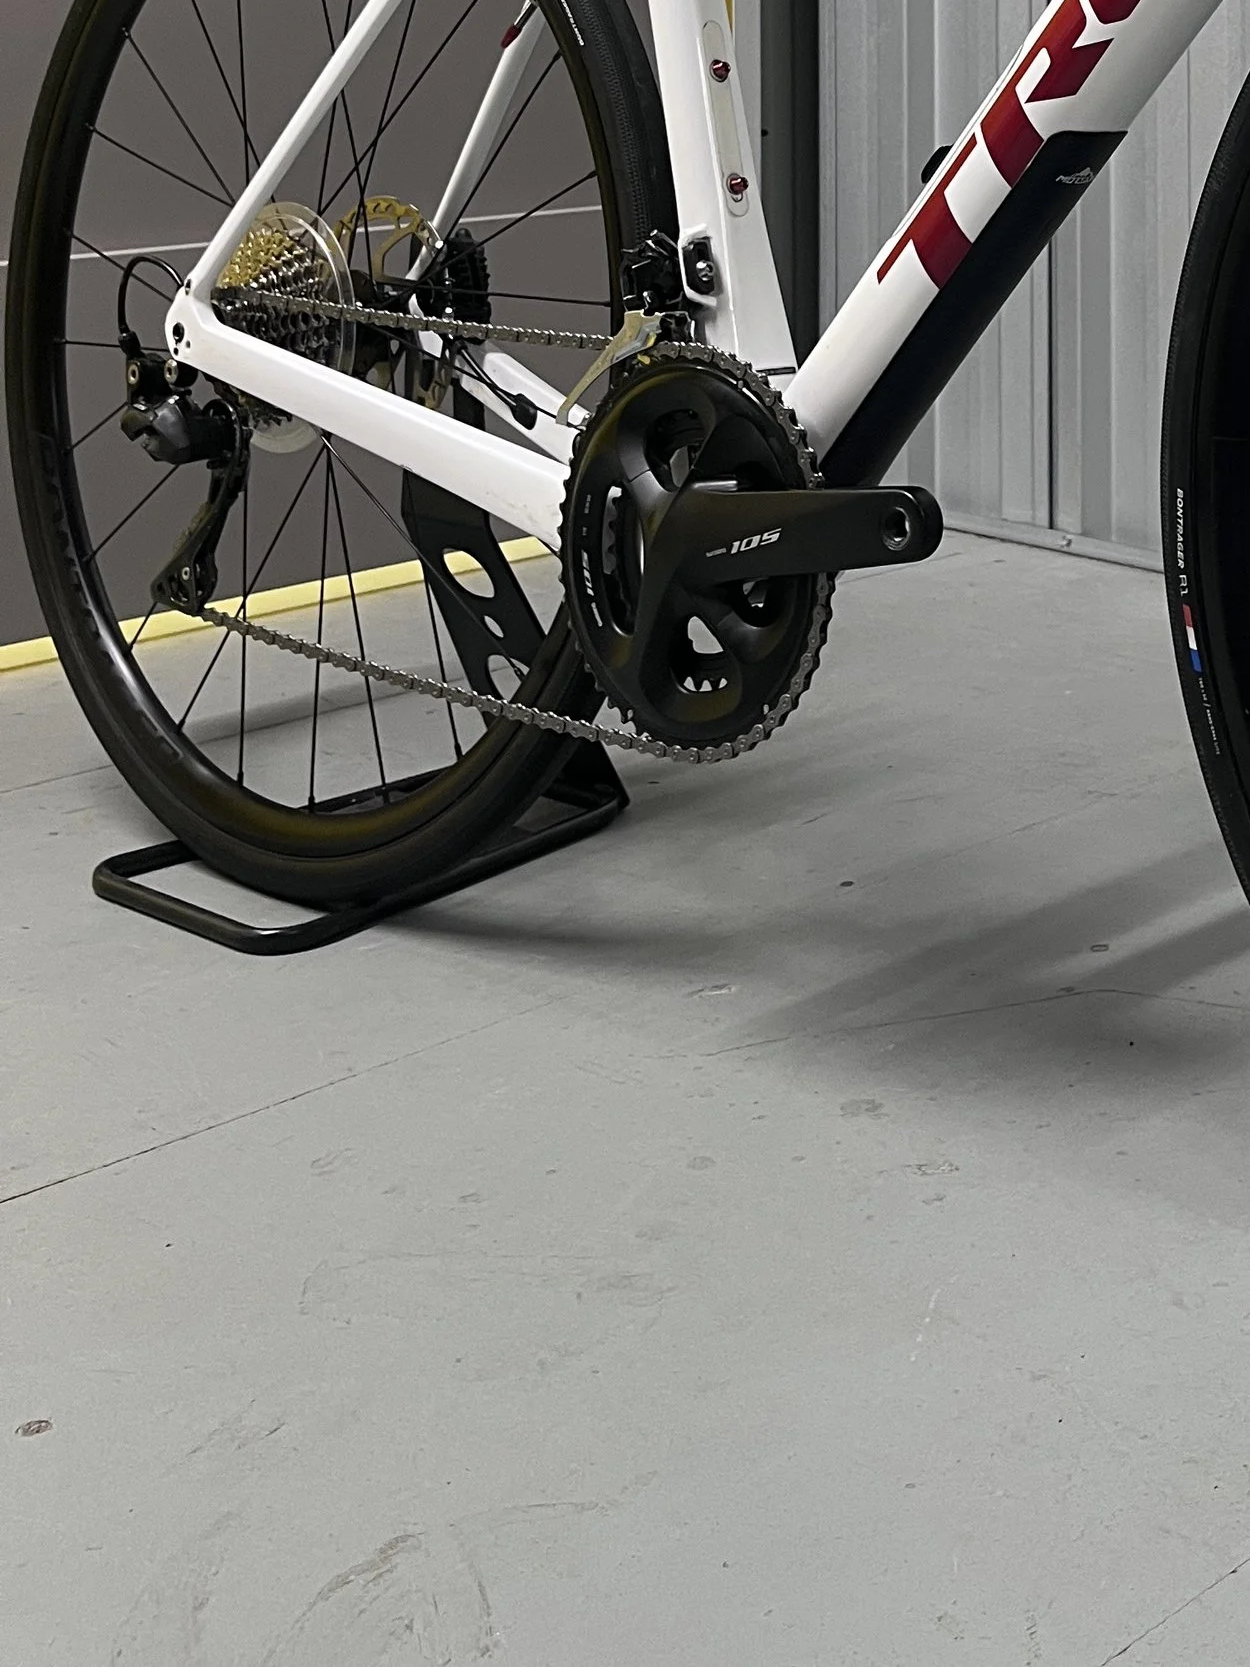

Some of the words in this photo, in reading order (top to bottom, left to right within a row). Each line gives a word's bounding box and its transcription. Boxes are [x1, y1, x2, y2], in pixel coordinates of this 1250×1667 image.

[730, 527, 782, 555] 105
[1176, 487, 1186, 570] BONTRAGER
[1178, 574, 1189, 597] R1
